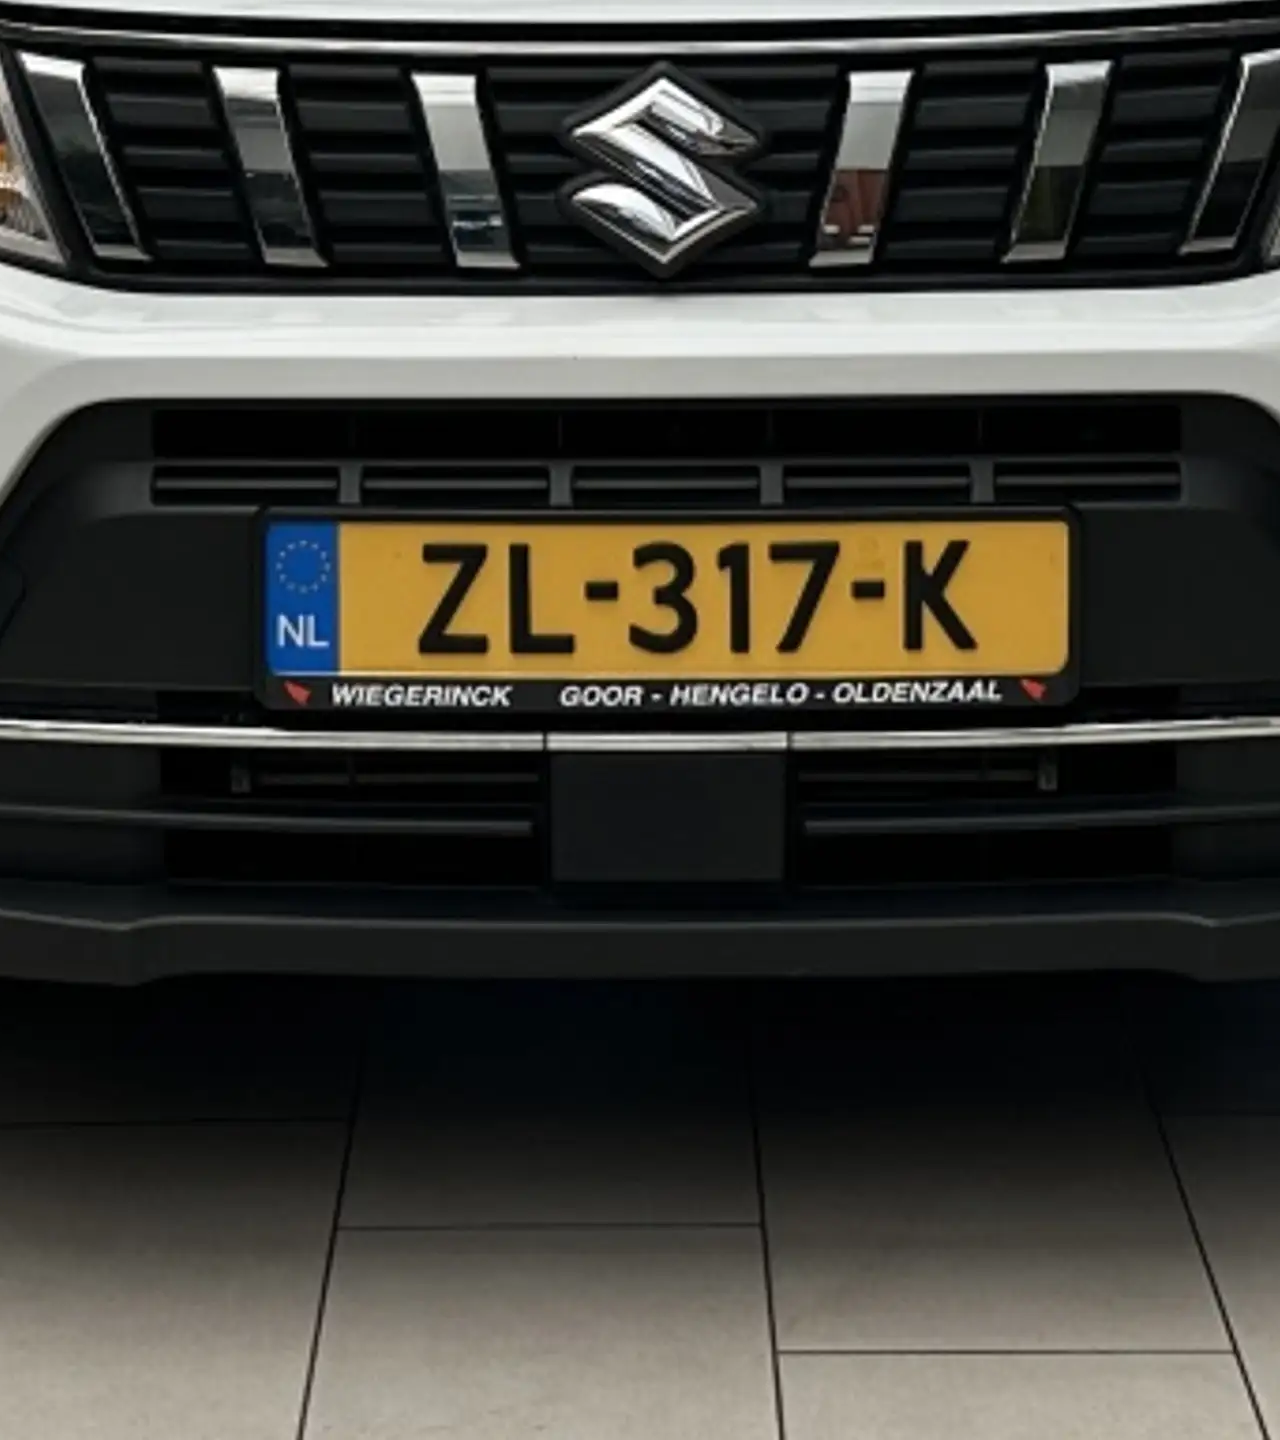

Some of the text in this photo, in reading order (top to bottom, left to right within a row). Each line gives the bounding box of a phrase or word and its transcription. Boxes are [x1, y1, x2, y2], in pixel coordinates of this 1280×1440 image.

[417, 539, 979, 655] ZL-317-K
[276, 614, 330, 649] NL
[331, 684, 513, 707] WIEGERINCK
[559, 684, 644, 707] GOOR
[669, 682, 810, 706] HENGELO
[831, 679, 1003, 704] OLDENZAAL
